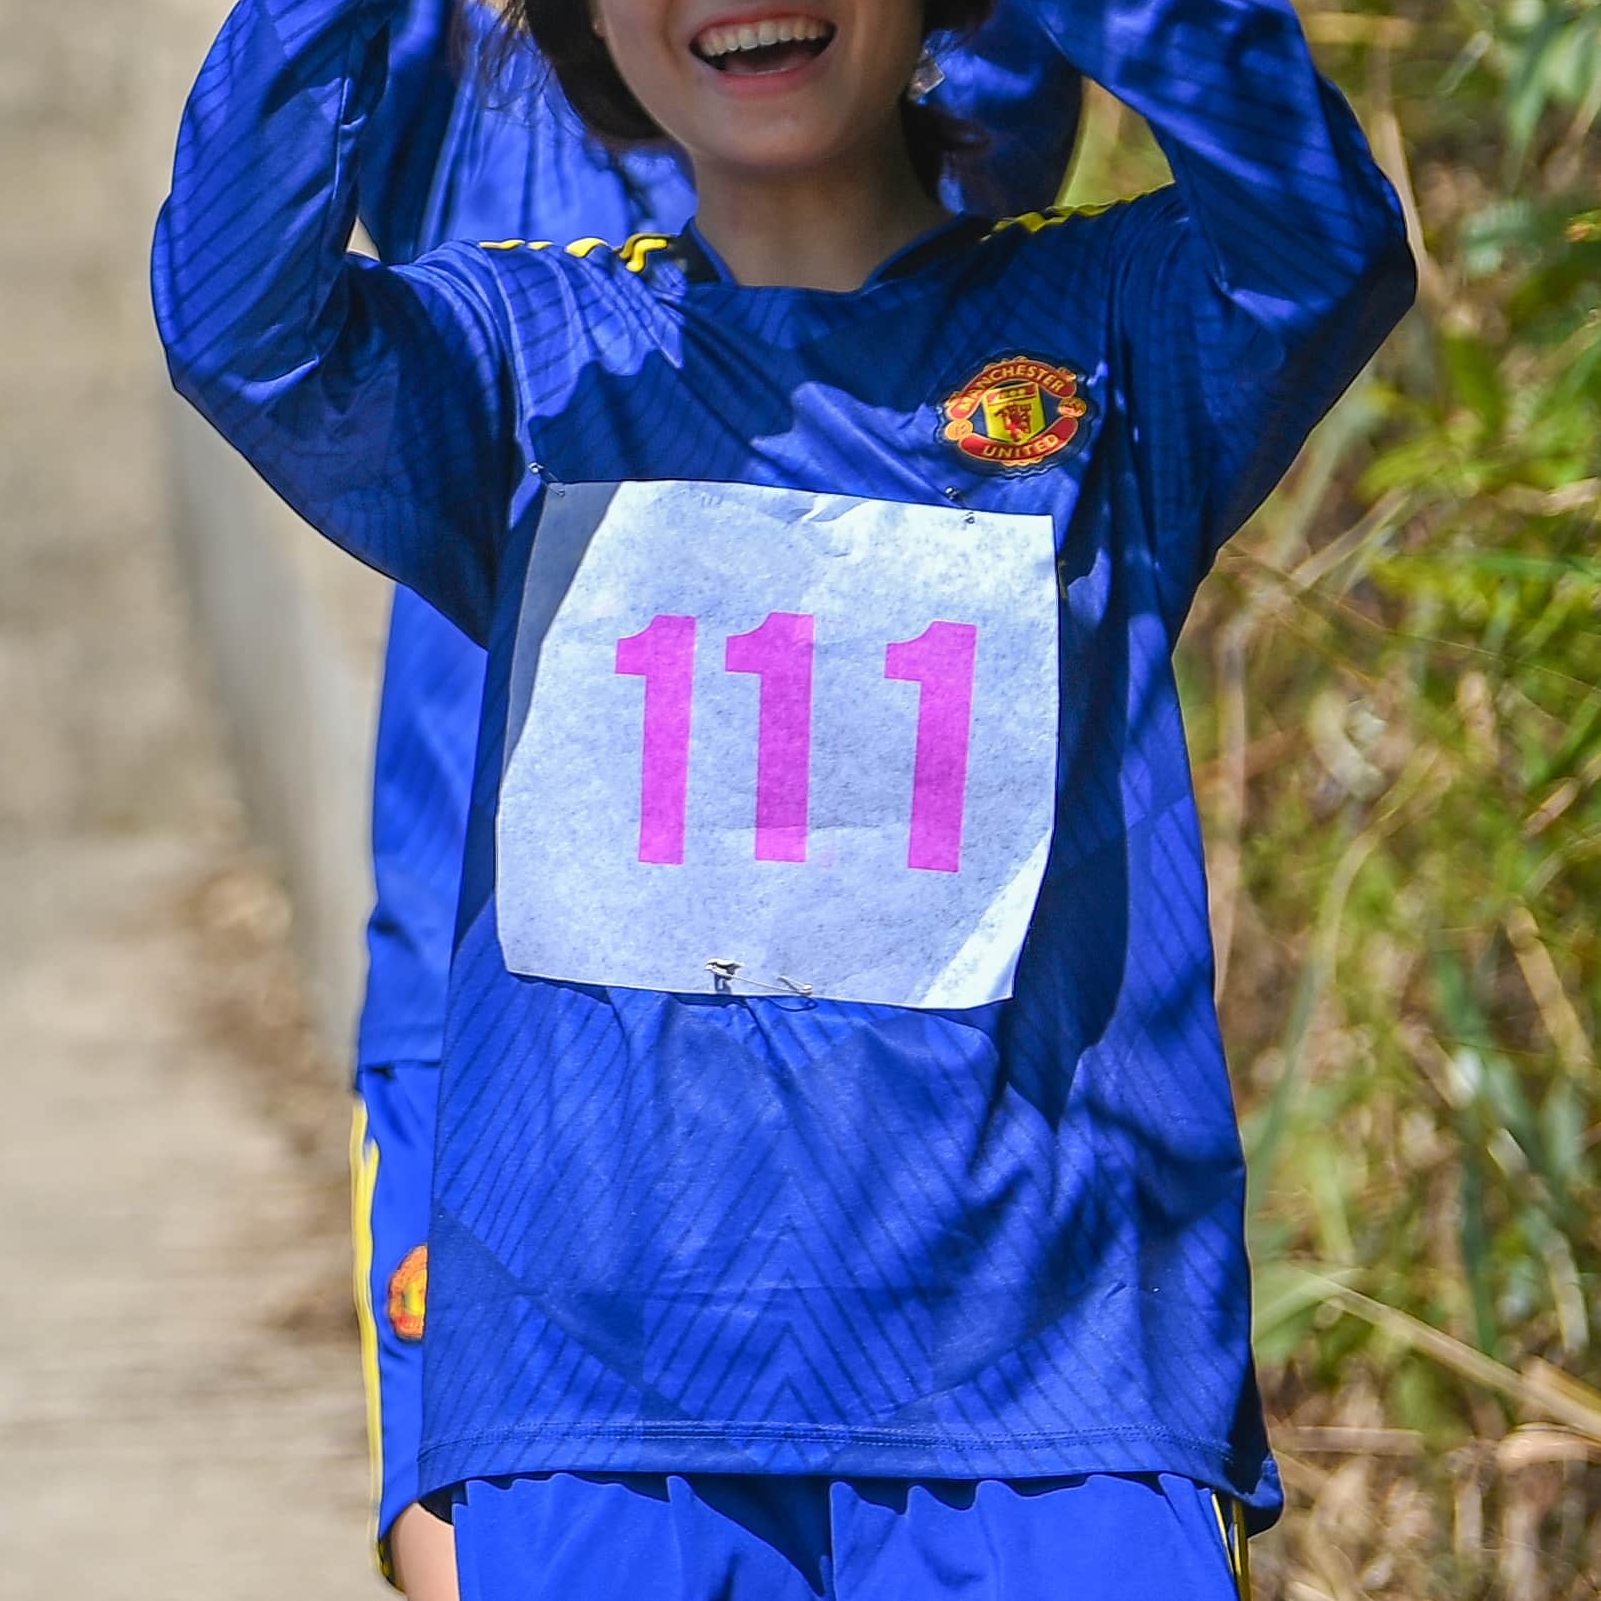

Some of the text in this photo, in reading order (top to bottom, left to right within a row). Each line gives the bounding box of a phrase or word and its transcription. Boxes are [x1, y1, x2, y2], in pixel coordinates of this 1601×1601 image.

[957, 364, 1066, 411] MANCHESTER
[981, 434, 1059, 458] UNITED
[613, 611, 978, 873] 111
